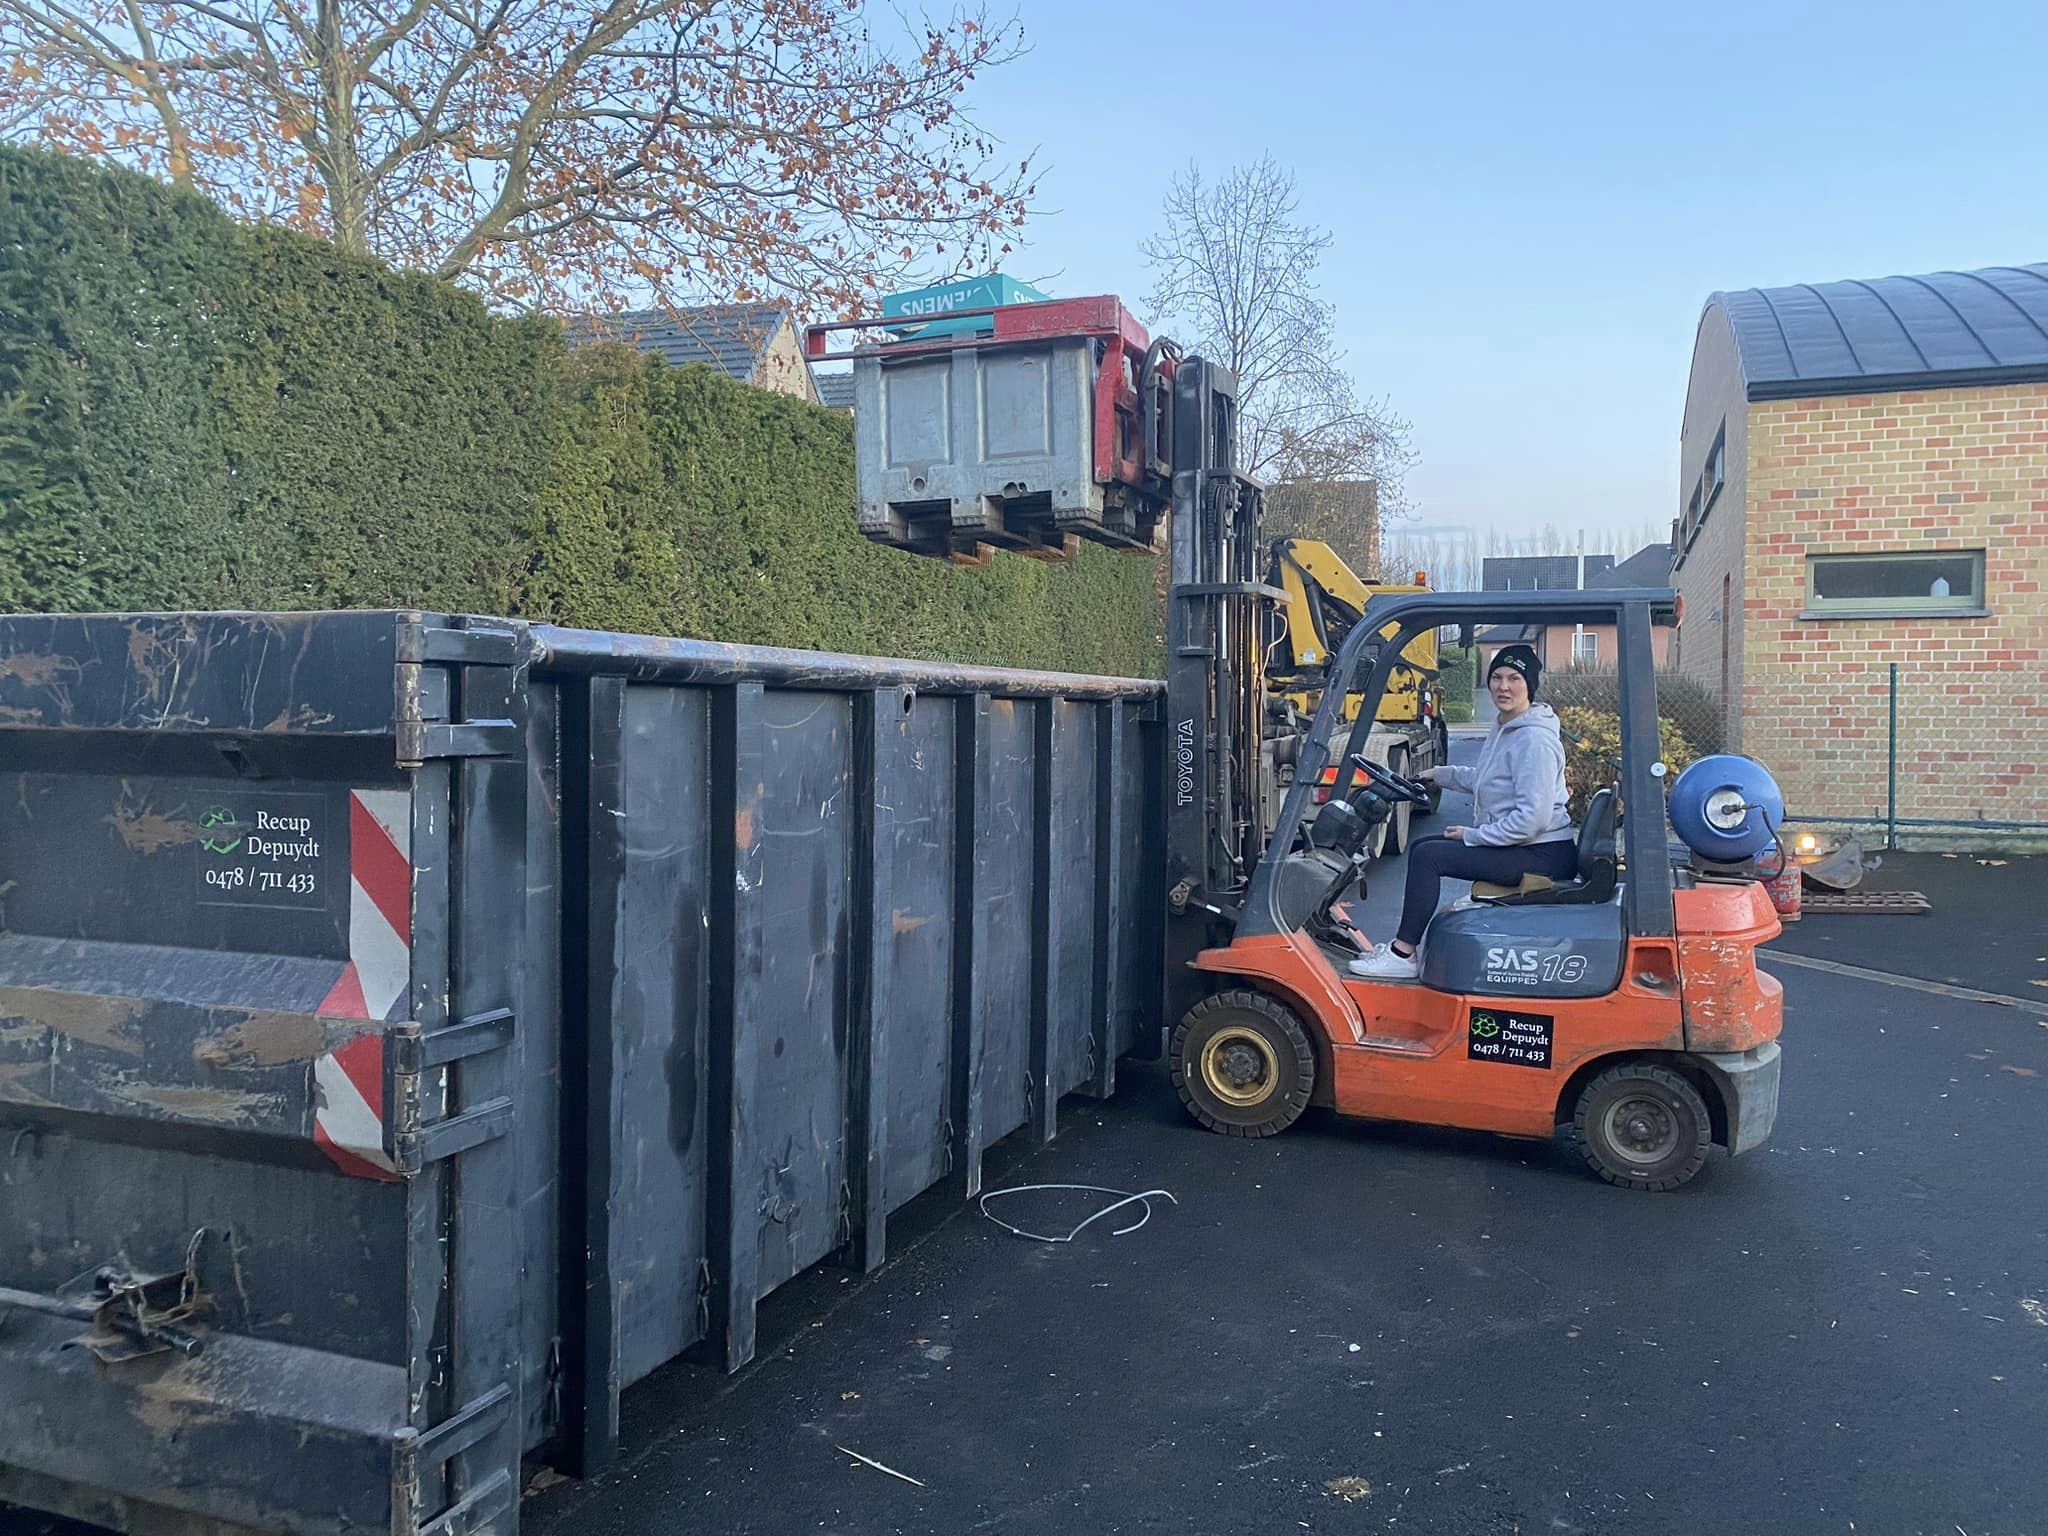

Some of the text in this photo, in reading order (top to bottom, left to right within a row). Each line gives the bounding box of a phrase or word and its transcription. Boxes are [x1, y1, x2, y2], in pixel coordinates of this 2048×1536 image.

[901, 286, 982, 316] IEMENS
[1178, 719, 1193, 806] TOYOTA
[256, 811, 311, 837] Recup
[248, 836, 320, 862] Depuydt
[206, 866, 315, 894] 0478 / 711 433
[1487, 948, 1538, 971] SAS
[1542, 954, 1587, 983] 18
[1487, 975, 1538, 985] EQUIPPED
[1502, 1030, 1549, 1046] Depuydt
[1509, 1019, 1544, 1035] Recup
[1473, 1043, 1545, 1062] 0478 / 711 433
